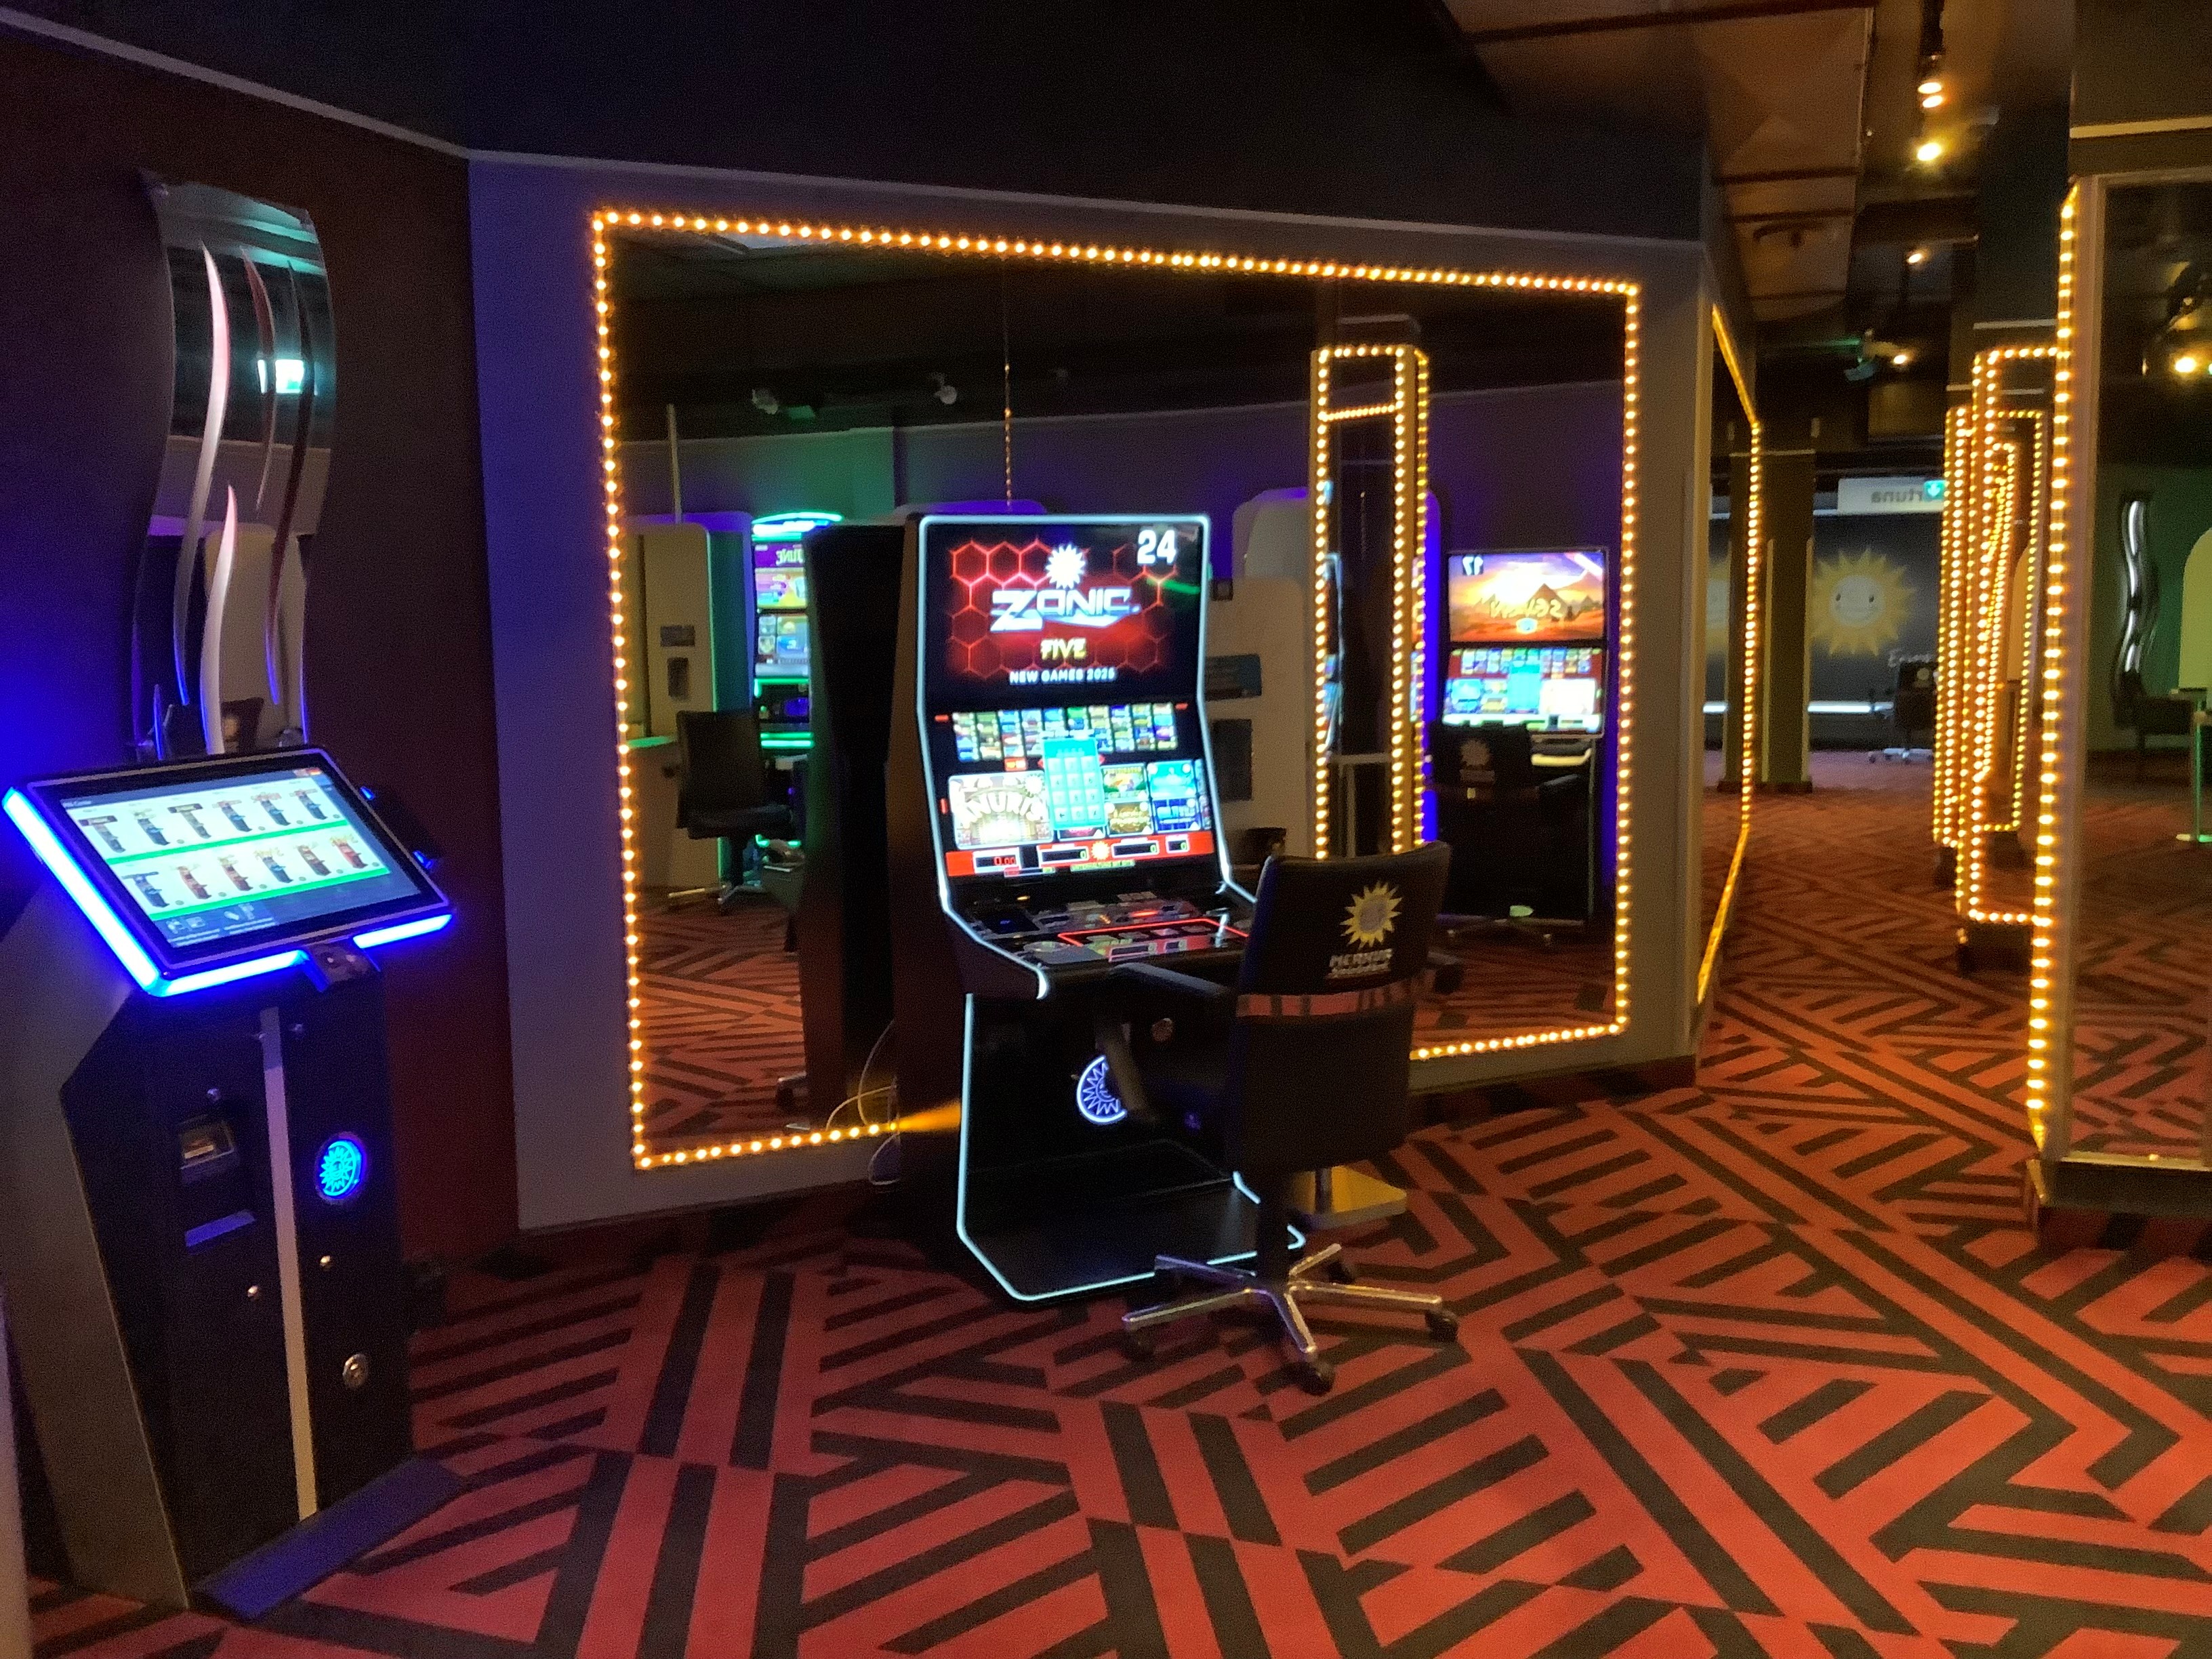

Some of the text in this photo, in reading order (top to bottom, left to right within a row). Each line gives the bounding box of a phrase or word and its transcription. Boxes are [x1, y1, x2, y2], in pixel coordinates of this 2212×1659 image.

[1137, 529, 1177, 565] 24
[1040, 637, 1086, 660] FIVE
[1010, 670, 1039, 684] NEW
[1041, 668, 1084, 682] GAMES
